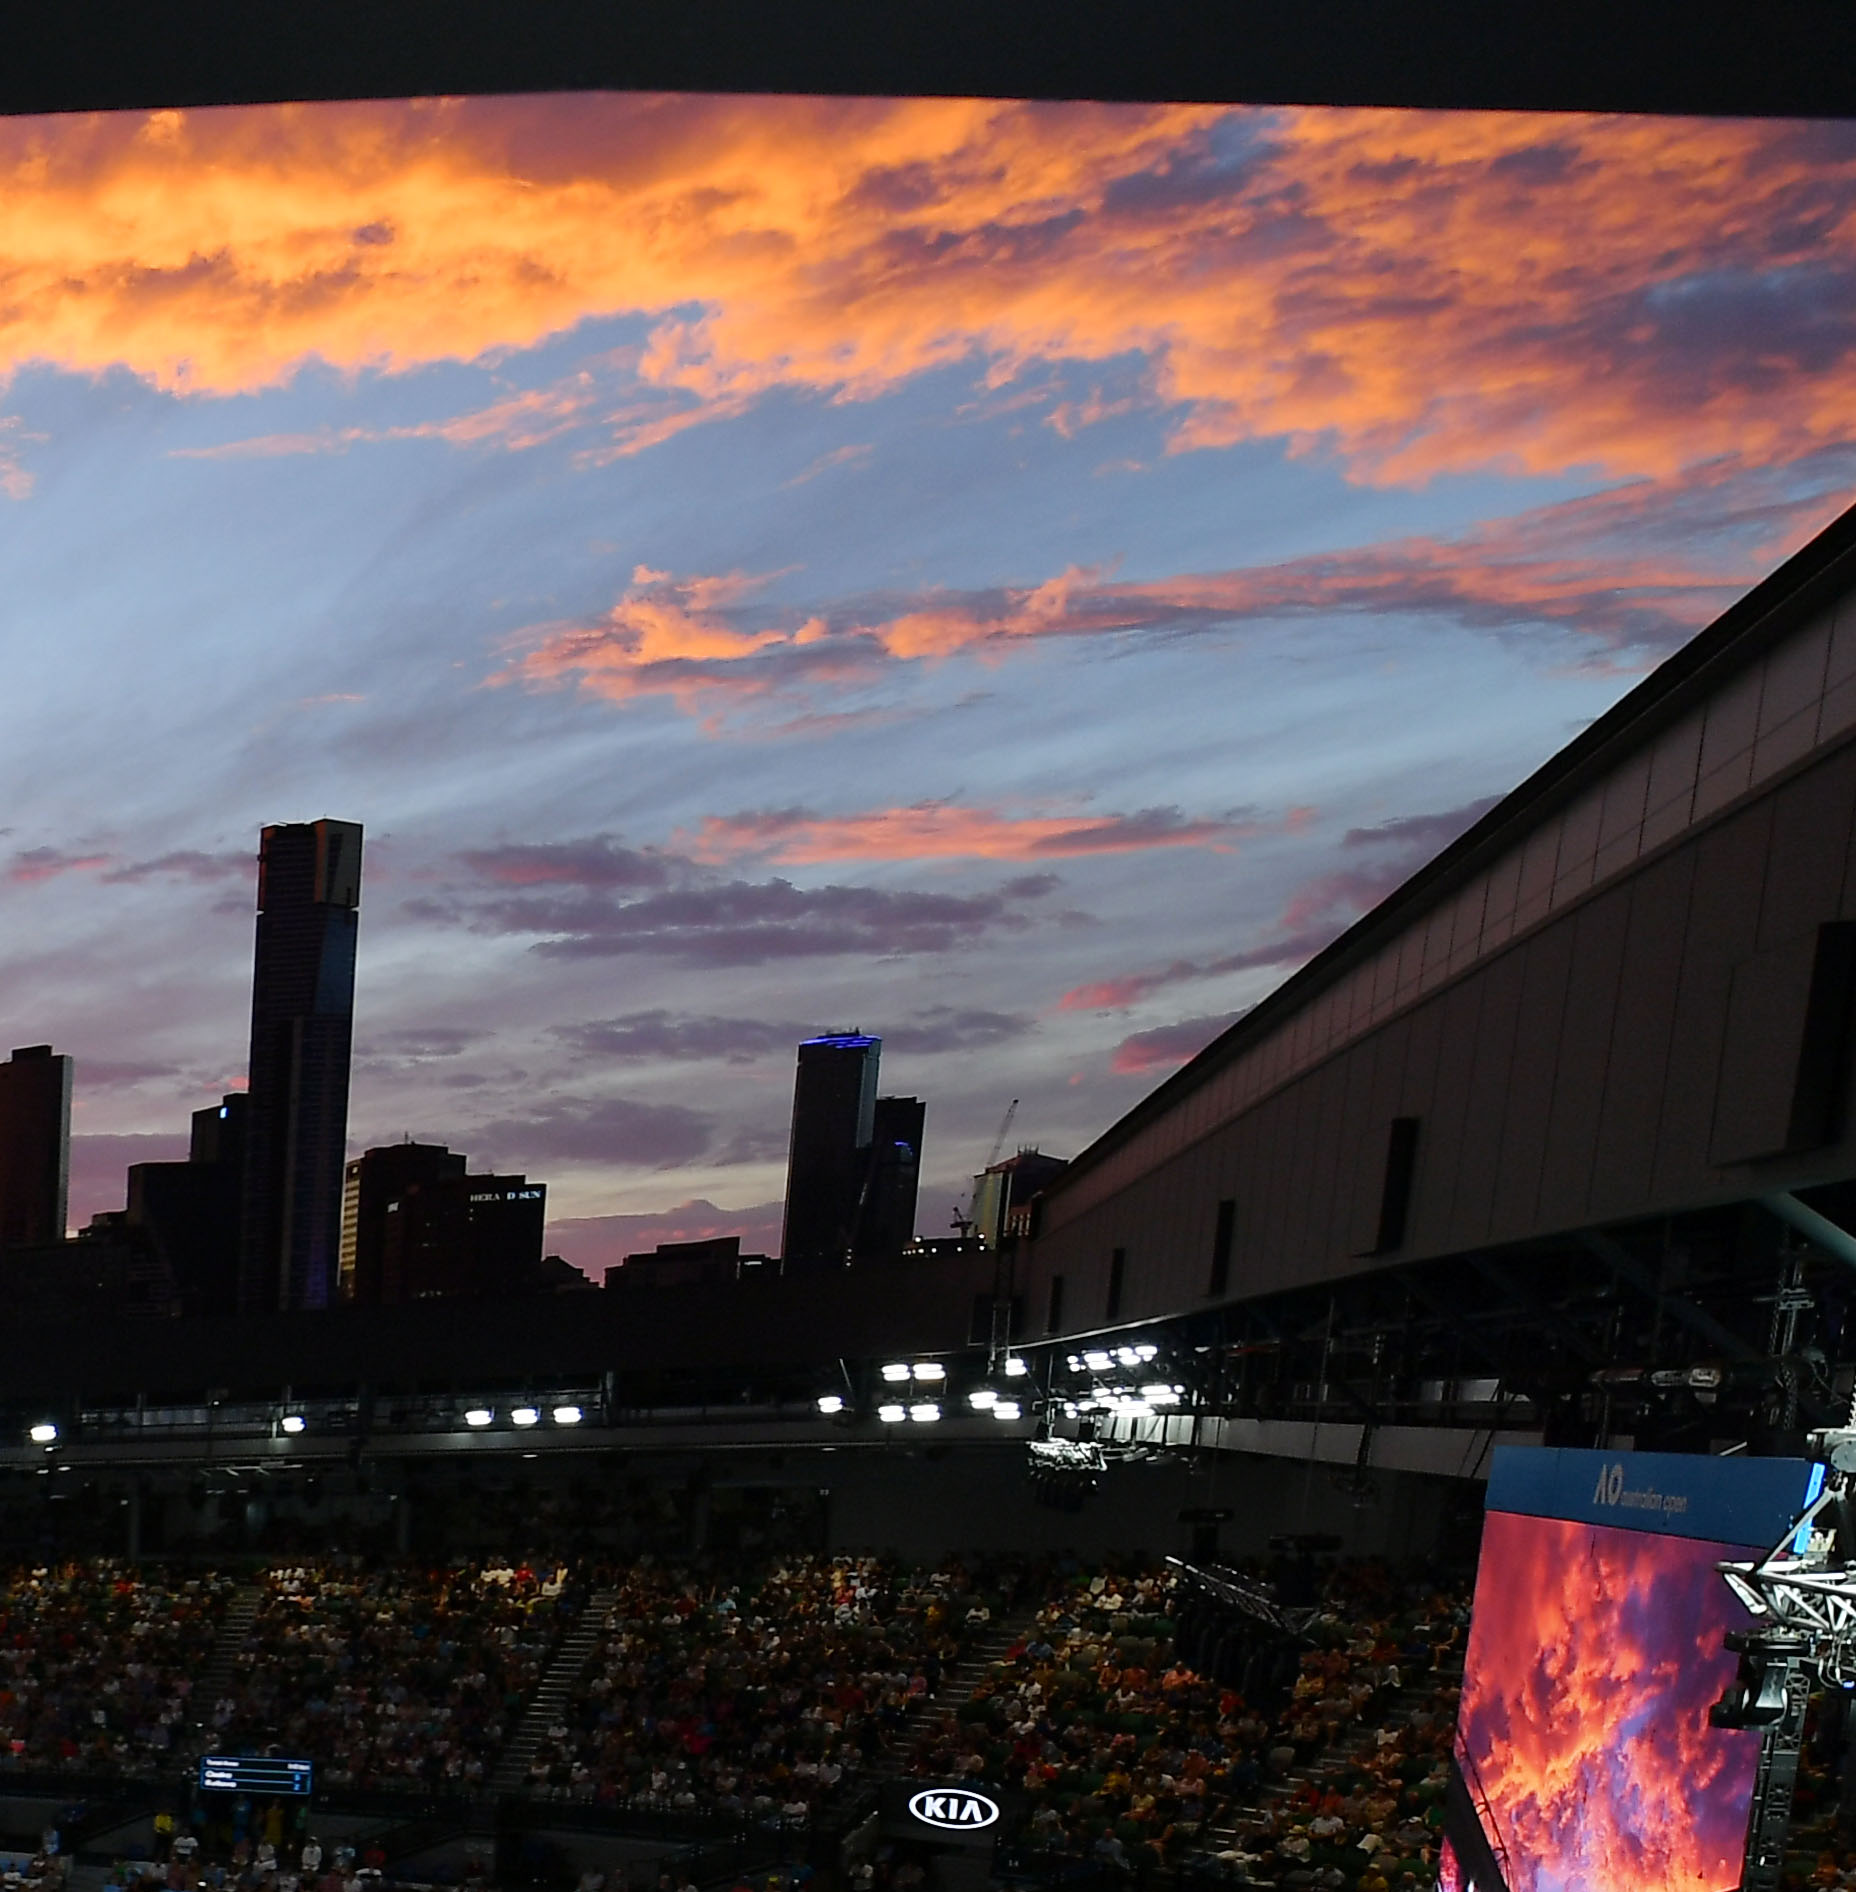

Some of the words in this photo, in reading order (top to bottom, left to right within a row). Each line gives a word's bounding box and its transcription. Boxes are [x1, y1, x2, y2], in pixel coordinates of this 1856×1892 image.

[469, 1191, 515, 1202] HERAD
[518, 1190, 542, 1200] SUN
[1593, 1463, 1623, 1505] AO
[924, 1796, 983, 1822] KIA
